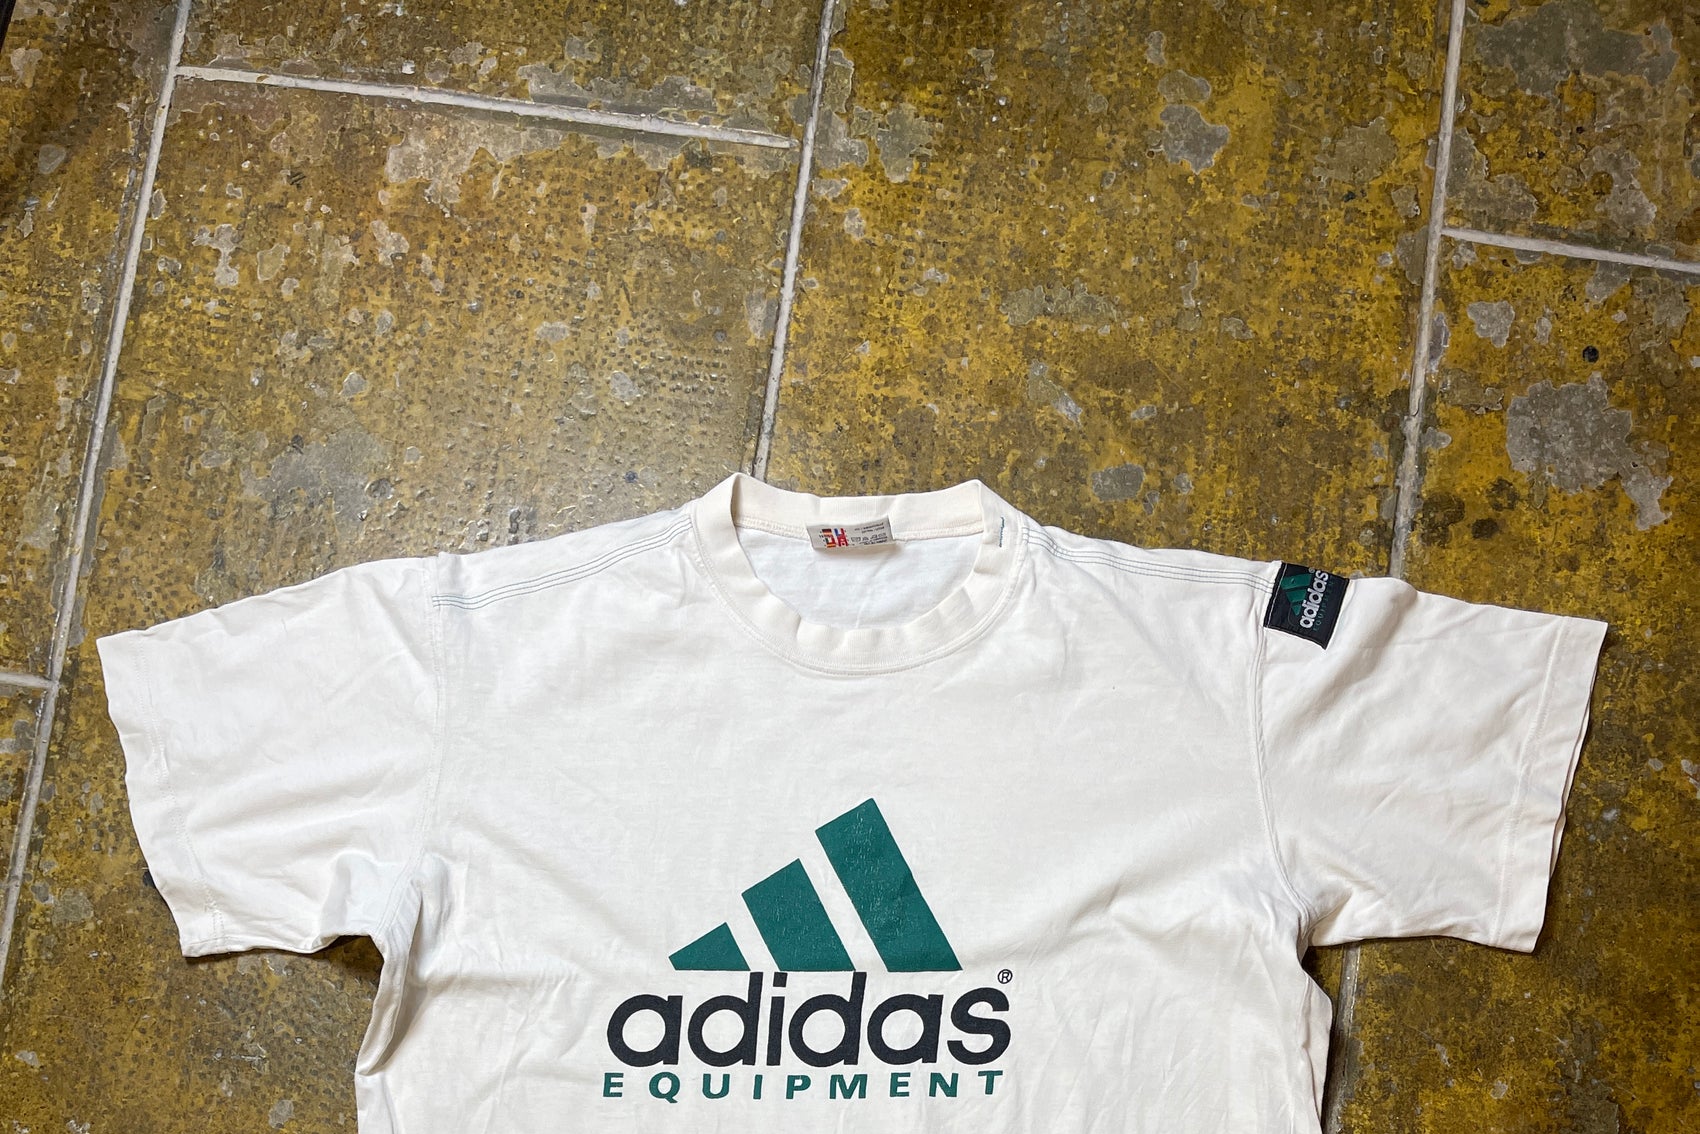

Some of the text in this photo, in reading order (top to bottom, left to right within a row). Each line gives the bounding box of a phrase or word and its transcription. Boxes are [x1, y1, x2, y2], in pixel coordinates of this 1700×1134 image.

[1299, 570, 1329, 629] adidas
[606, 971, 1013, 1068] adidas
[603, 1070, 1003, 1104] EQUIPMENT
